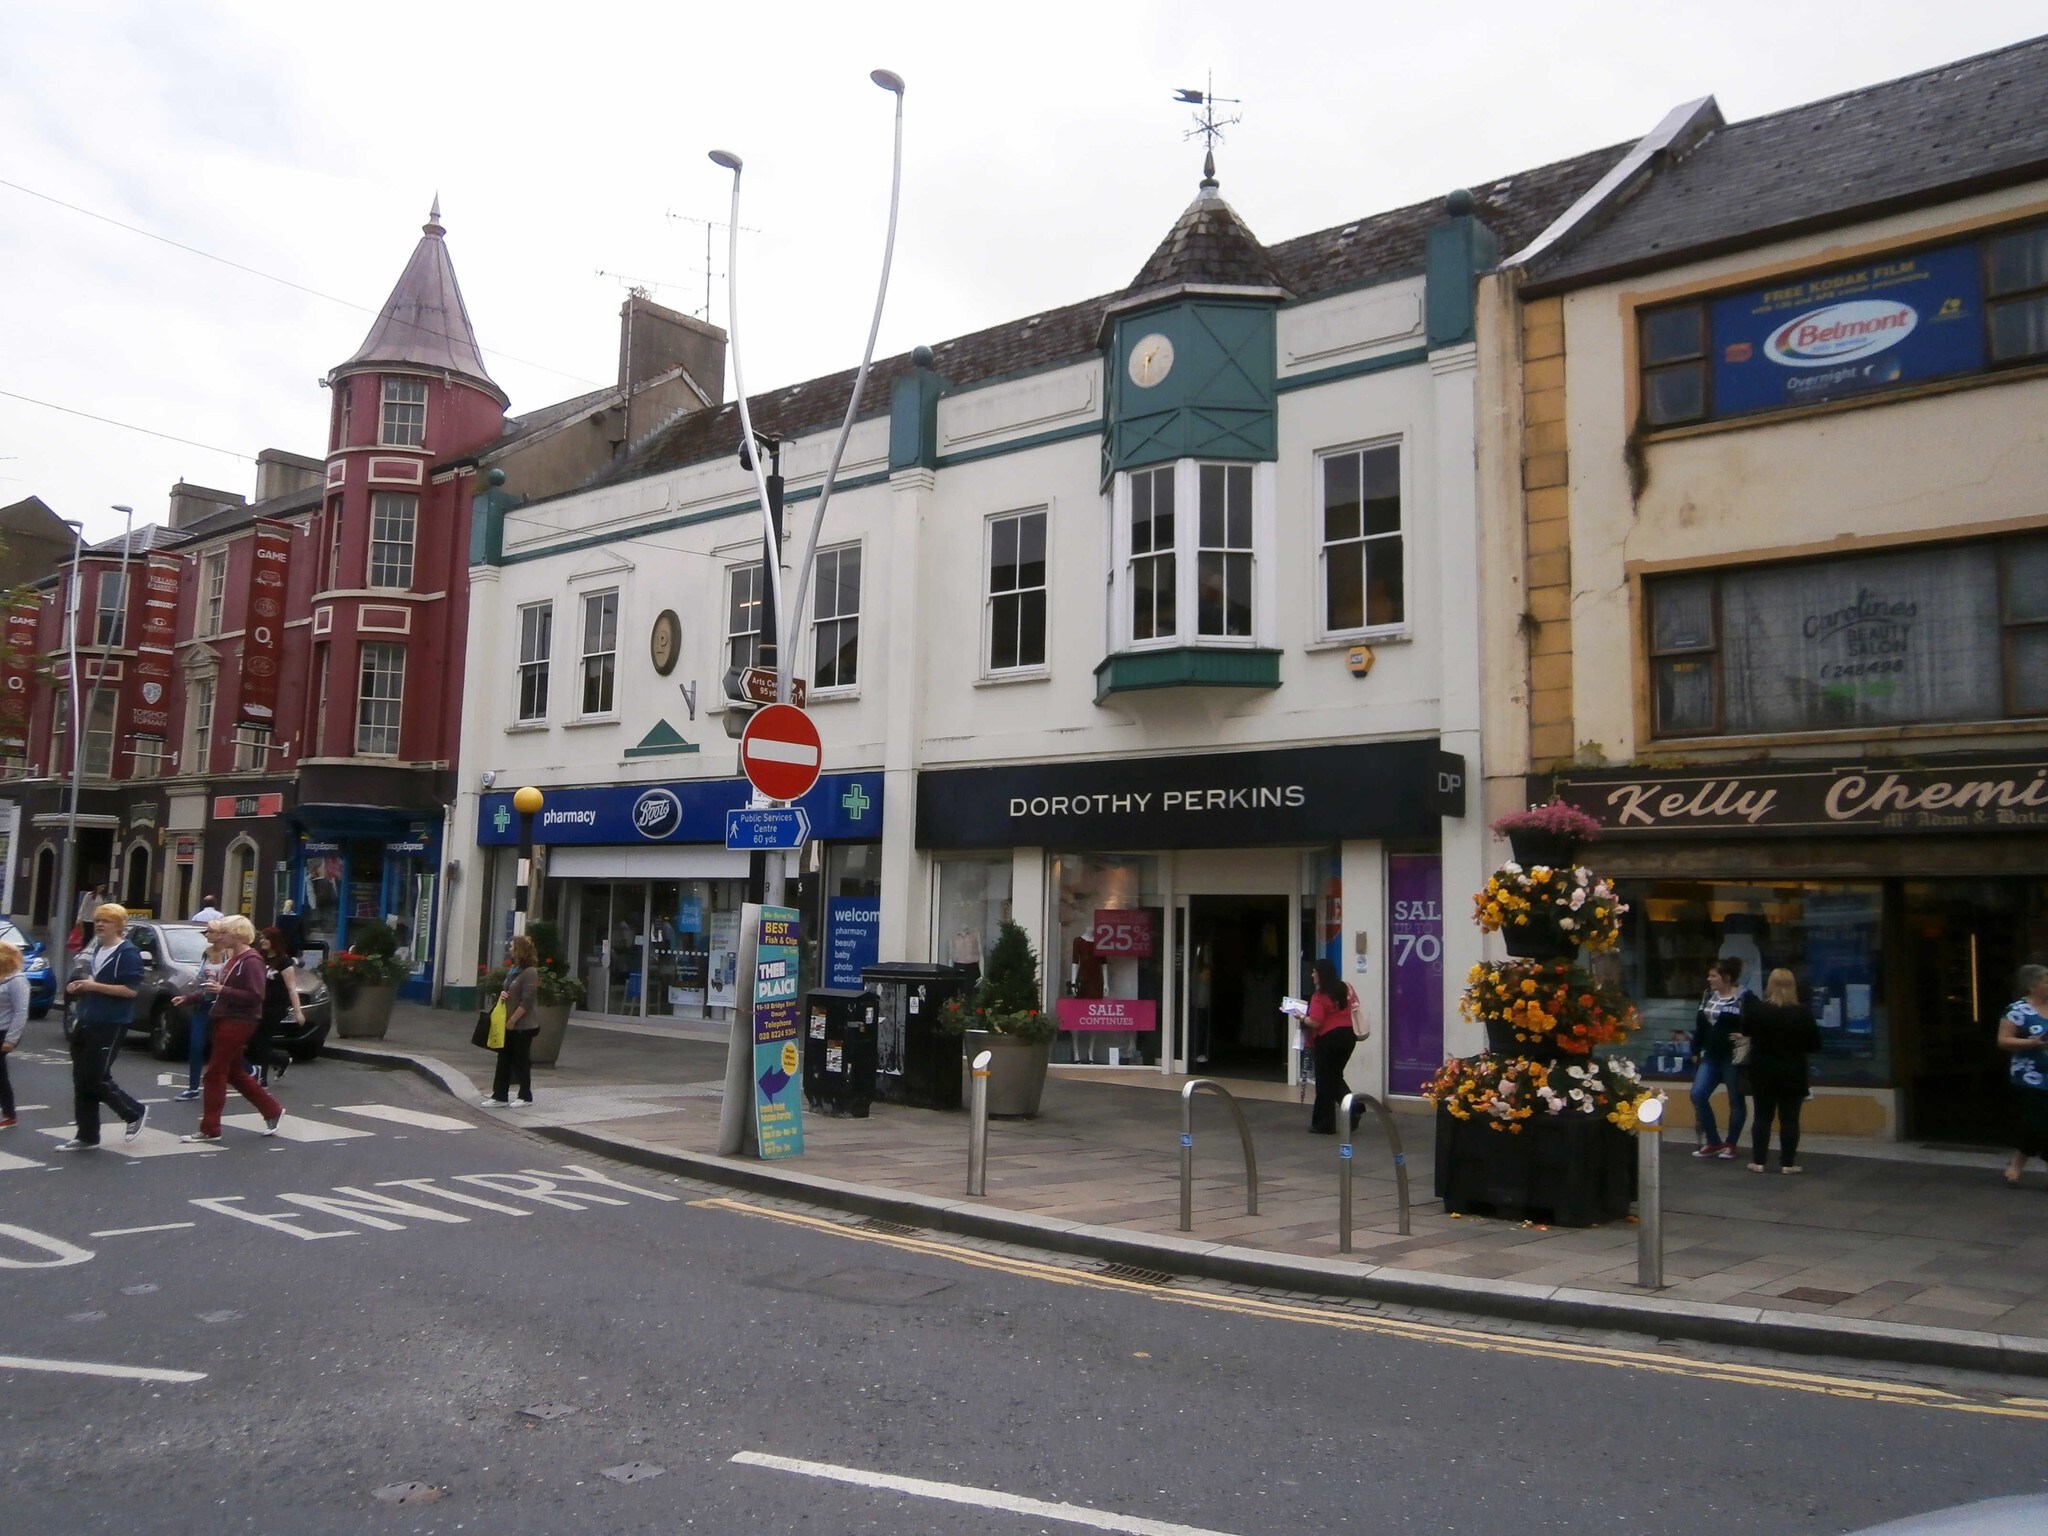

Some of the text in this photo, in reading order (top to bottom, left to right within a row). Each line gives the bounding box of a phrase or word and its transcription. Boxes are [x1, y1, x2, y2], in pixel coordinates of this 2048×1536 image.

[1763, 260, 1916, 303] FREE KODAK FILM
[1797, 308, 1911, 347] Belmont
[1786, 366, 1857, 390] Overnight
[257, 549, 287, 563] GAME
[9, 615, 38, 627] GAME
[1847, 625, 1910, 642] BEAUTY
[1848, 639, 1908, 657] SALON
[752, 677, 765, 686] Arts
[760, 687, 777, 697] 95 yd
[1438, 772, 1461, 794] DP
[1825, 767, 2048, 819] Chemi
[1009, 785, 1306, 817] DOROTHY PERKINS
[1607, 784, 1777, 826] Kelly
[543, 808, 596, 827] pharmacy
[637, 798, 670, 827] Boots
[740, 813, 793, 823] Public Services
[1915, 811, 1968, 826] Adam
[753, 824, 778, 833] Centre
[753, 834, 777, 845] 60 yds
[834, 907, 881, 922] welcom
[1394, 900, 1442, 921] SAL
[765, 922, 789, 934] BEST
[835, 926, 867, 937] pharmacy
[765, 936, 778, 944] Fish
[835, 939, 856, 949] beauty
[1095, 924, 1150, 951] 25%
[834, 950, 850, 960] baby
[1393, 934, 1442, 967] 70
[833, 962, 853, 972] photo
[1088, 1004, 1124, 1017] SALE
[764, 1020, 792, 1029] Telephone
[1079, 1017, 1134, 1026] CONTINUES
[188, 1165, 681, 1242] ENTRY
